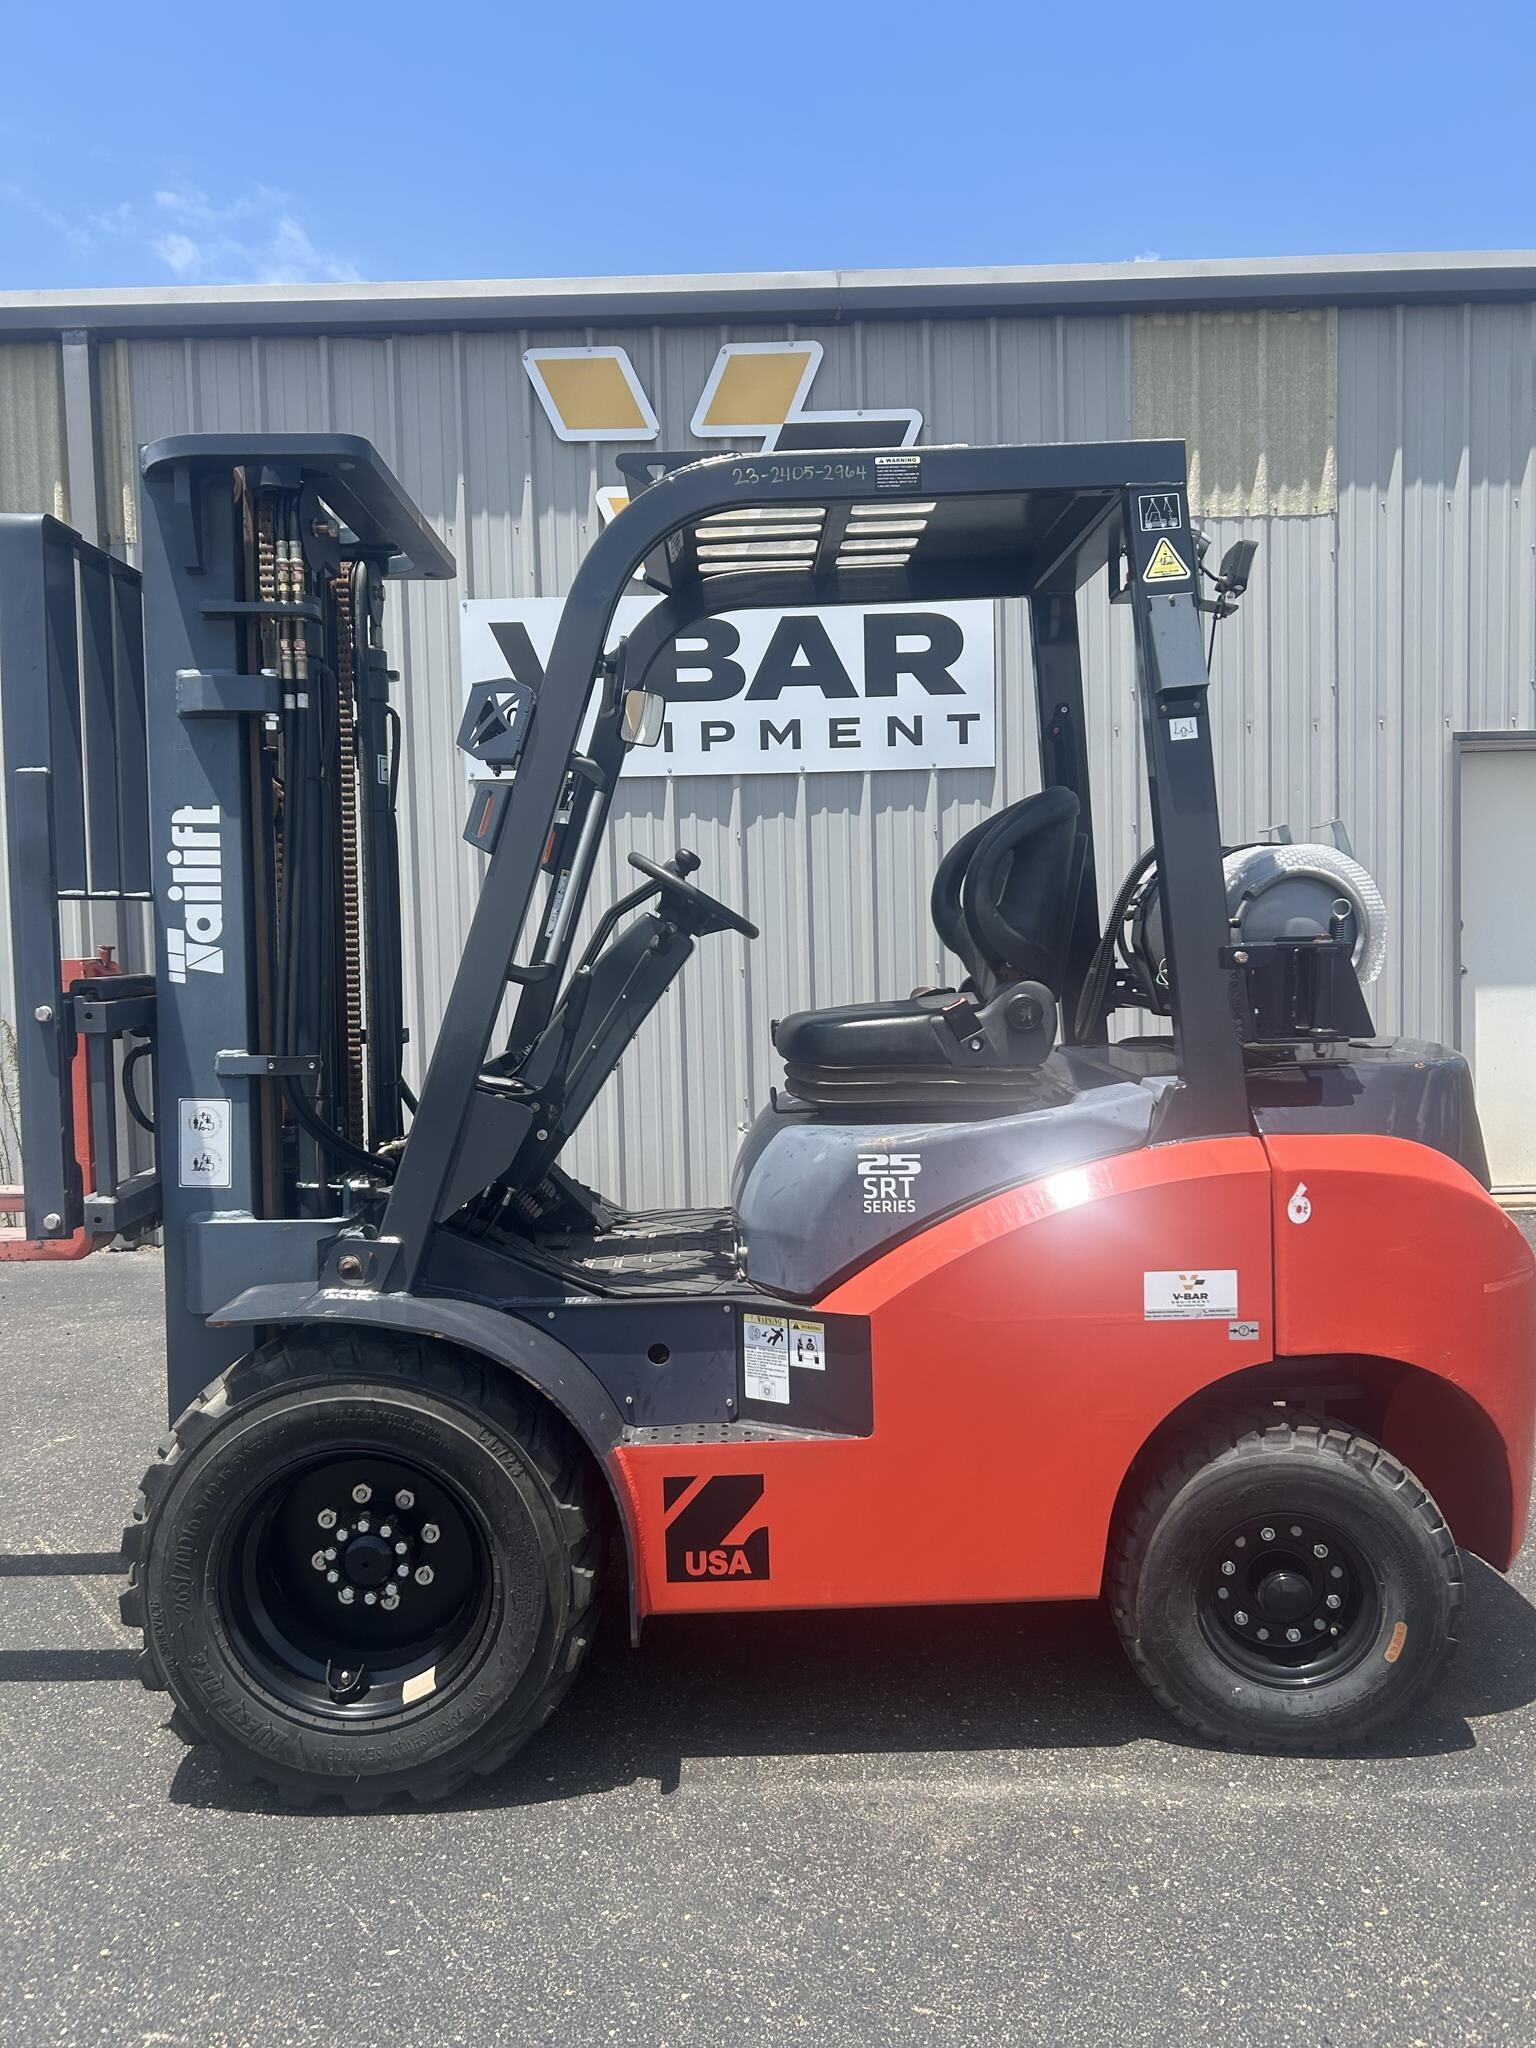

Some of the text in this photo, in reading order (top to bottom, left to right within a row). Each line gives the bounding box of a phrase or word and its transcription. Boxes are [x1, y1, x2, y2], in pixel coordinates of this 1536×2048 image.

[732, 464, 867, 486] 23-2405-2964
[166, 804, 224, 984] Tailift
[857, 1153, 922, 1175] 25
[863, 1177, 915, 1199] SRT
[863, 1200, 916, 1213] SERIES
[1287, 1181, 1312, 1224] 6
[685, 1549, 752, 1577] USA
